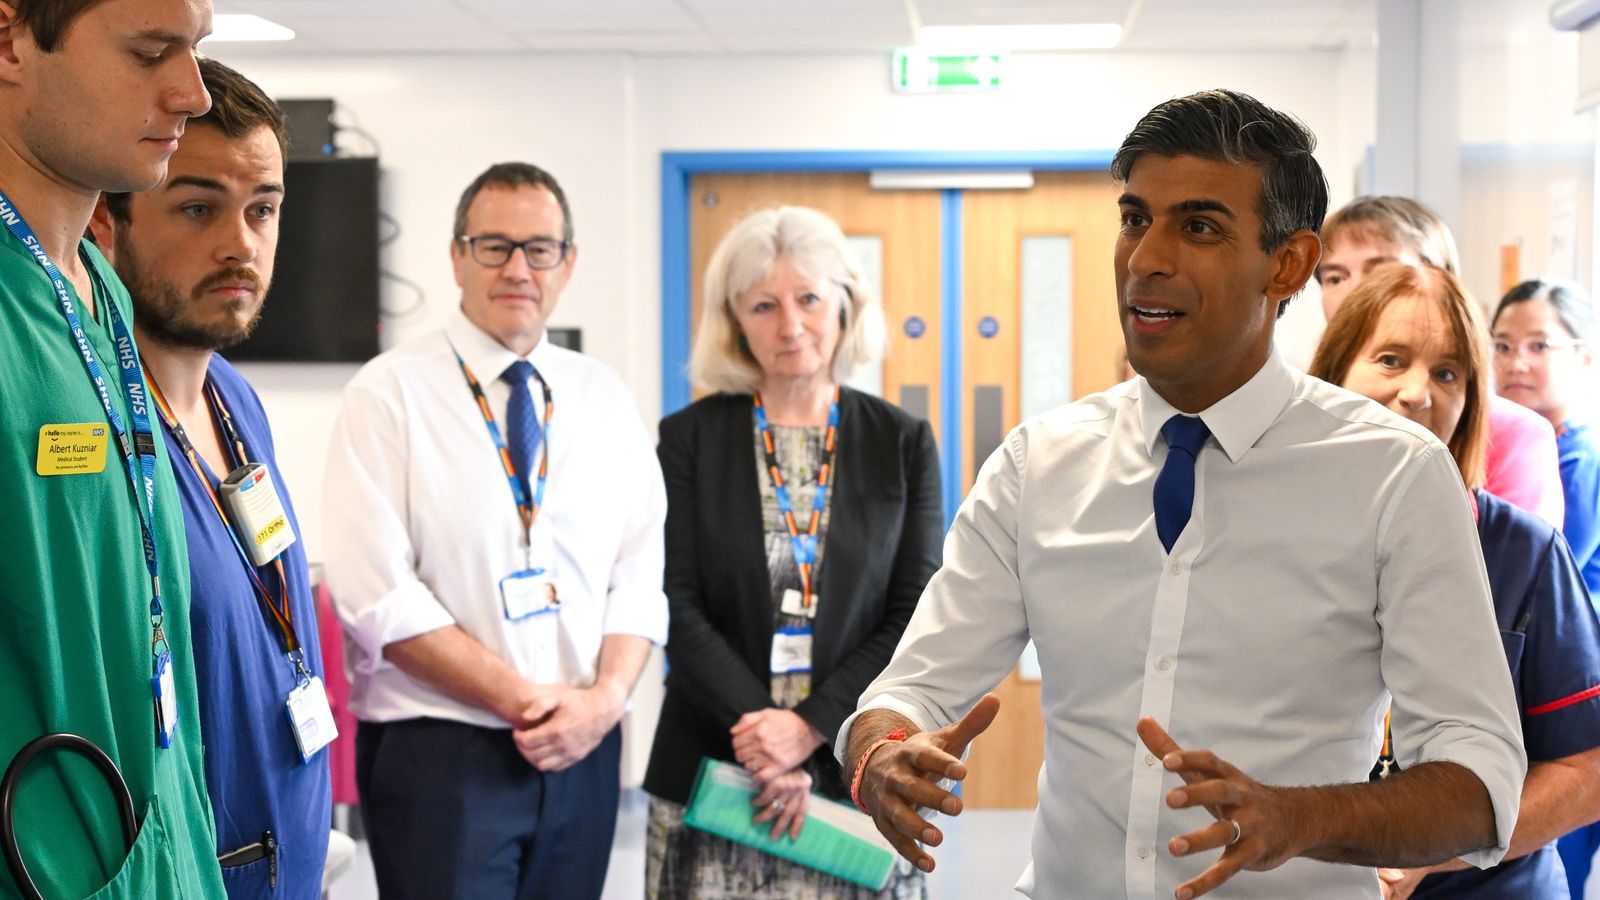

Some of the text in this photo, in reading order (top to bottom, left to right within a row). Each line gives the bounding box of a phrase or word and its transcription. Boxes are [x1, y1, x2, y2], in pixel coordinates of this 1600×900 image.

[0, 195, 20, 226] NH
[22, 235, 51, 266] NHS
[54, 279, 74, 314] NHS
[74, 327, 94, 363] NHS
[117, 336, 136, 370] NHS
[95, 375, 111, 410] NHS
[128, 383, 146, 415] NHS
[49, 443, 97, 453] Albert Kuzniar
